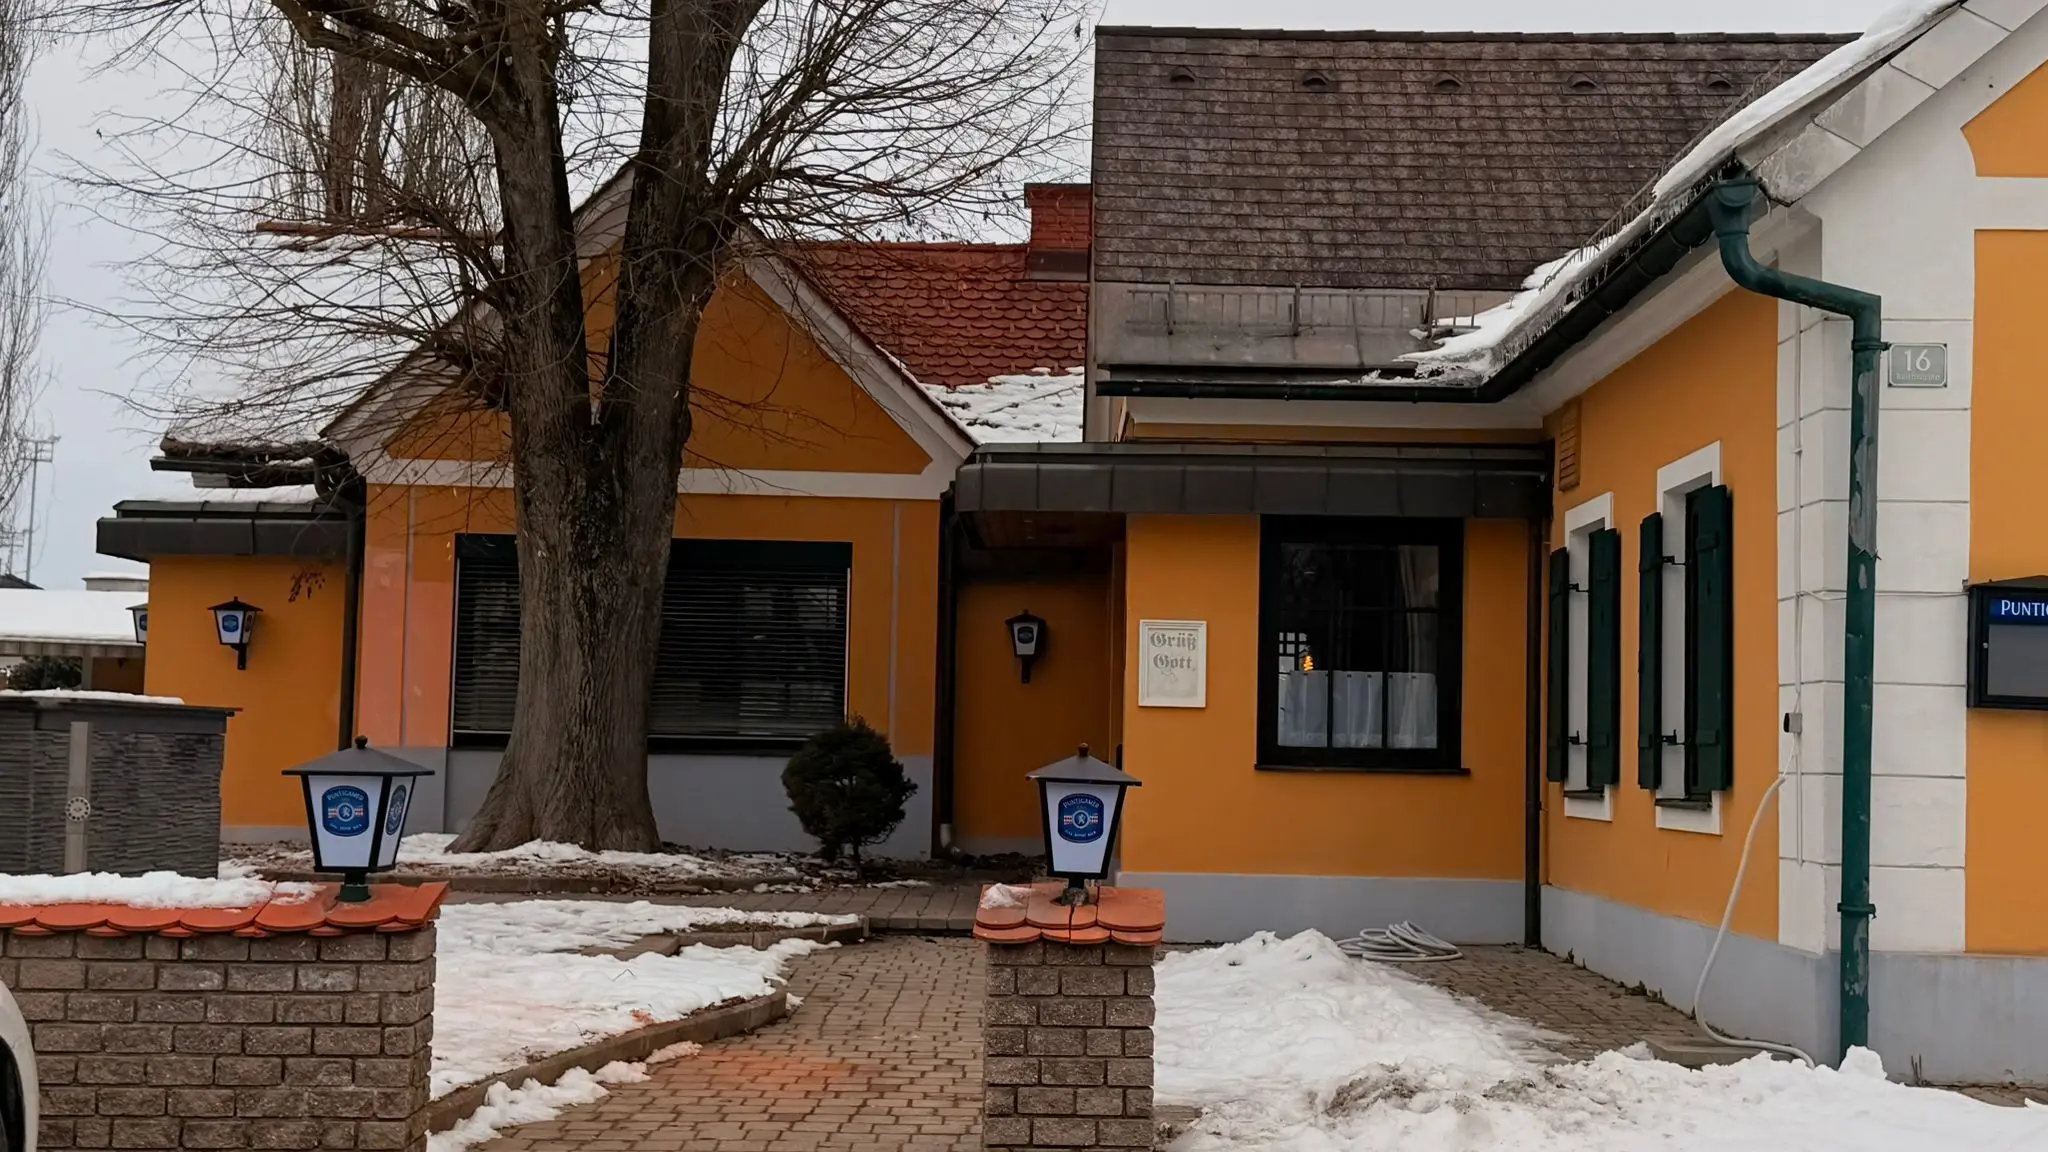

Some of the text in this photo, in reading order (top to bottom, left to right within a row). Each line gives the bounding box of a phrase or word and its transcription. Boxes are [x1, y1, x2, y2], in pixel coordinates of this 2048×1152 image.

[1904, 348, 1931, 371] 16
[2001, 600, 2048, 616] PUNTI
[1150, 632, 1197, 651] Grüß
[1153, 653, 1192, 669] Gott
